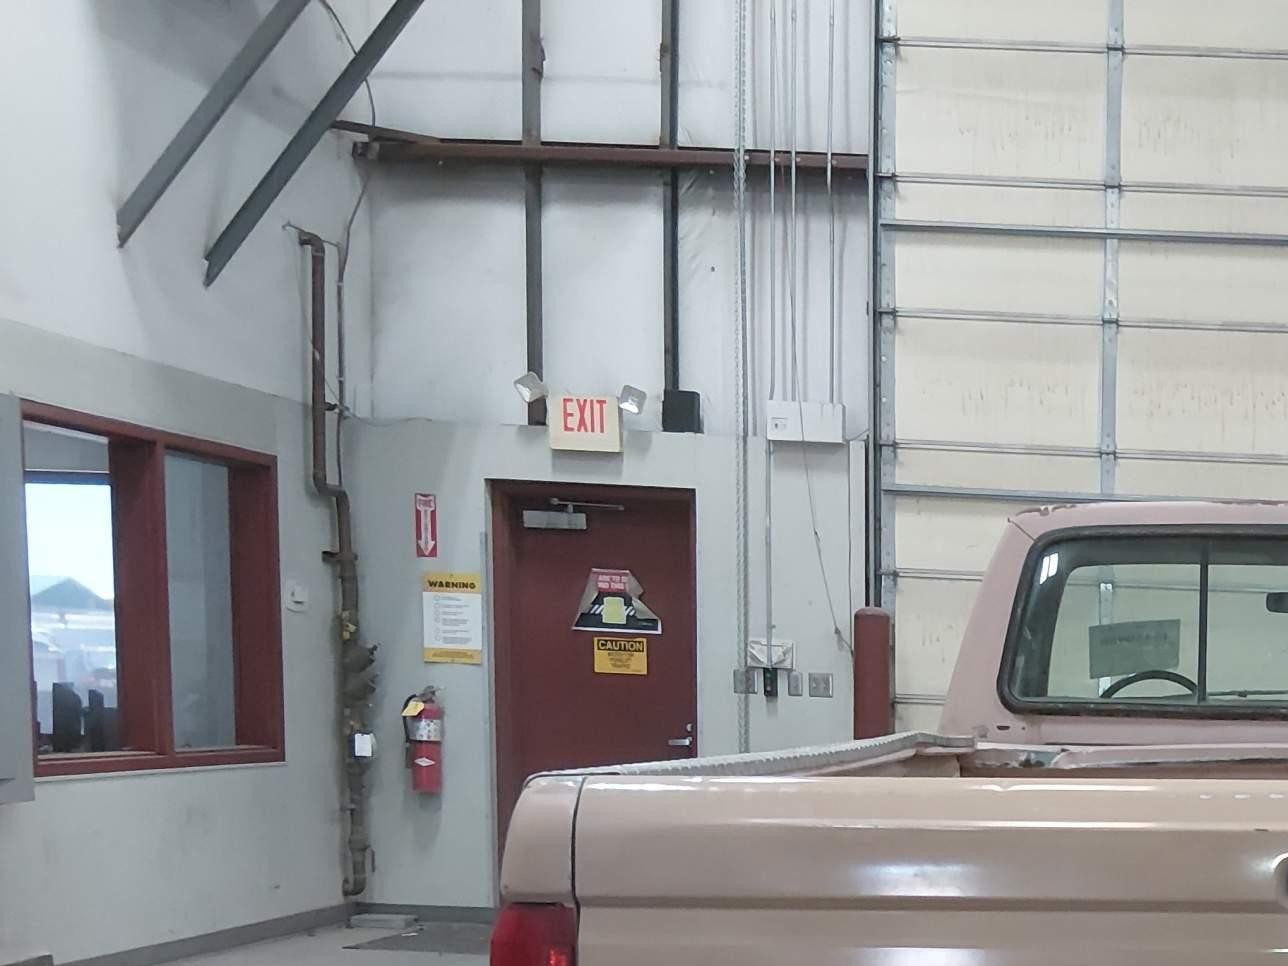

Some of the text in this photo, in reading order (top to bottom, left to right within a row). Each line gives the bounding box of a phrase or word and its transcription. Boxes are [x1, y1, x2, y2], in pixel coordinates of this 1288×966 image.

[562, 398, 607, 434] EXIT
[427, 580, 477, 590] WARNING
[598, 640, 643, 651] CAUTION
